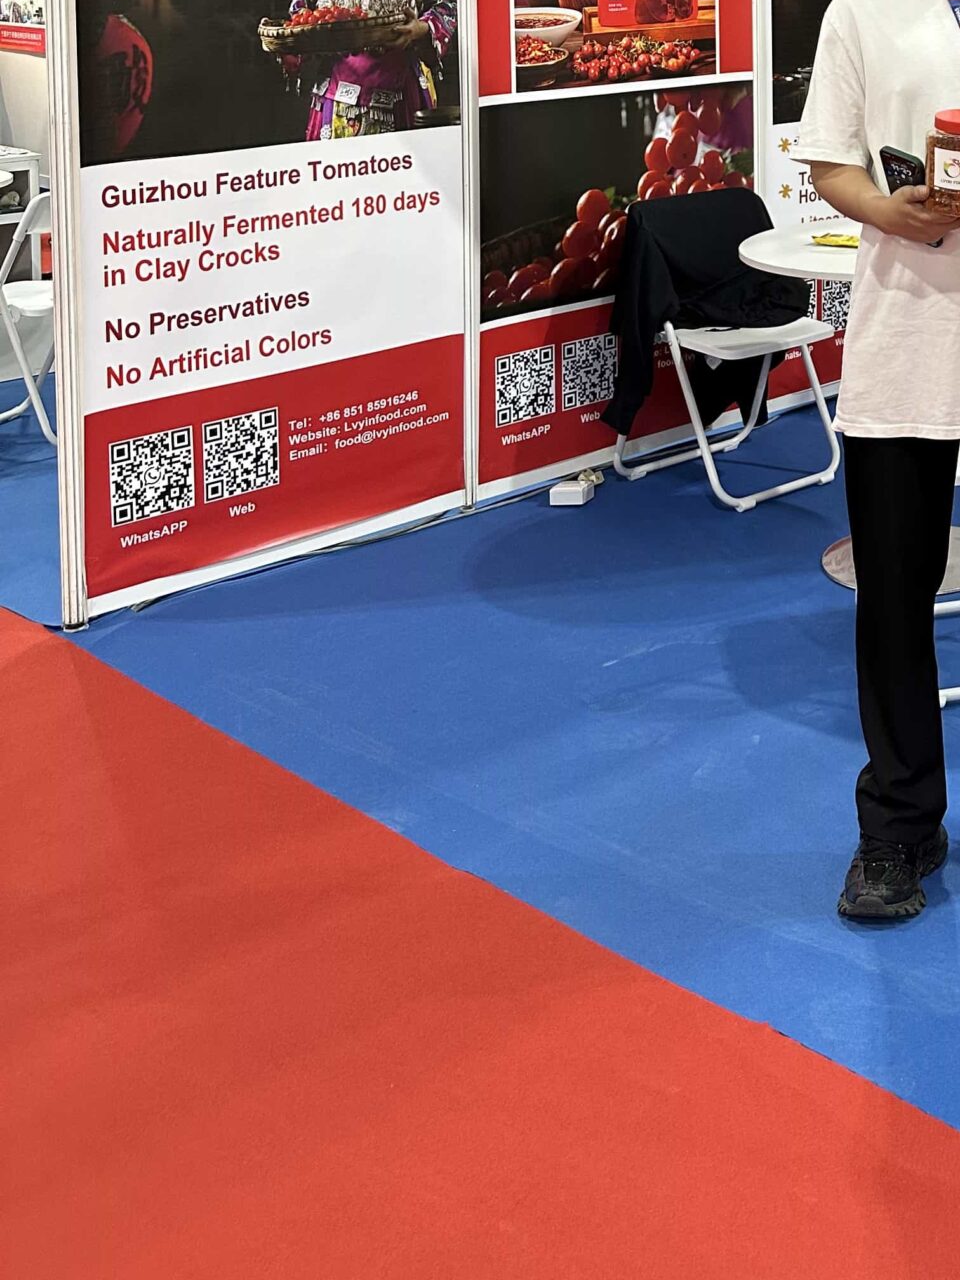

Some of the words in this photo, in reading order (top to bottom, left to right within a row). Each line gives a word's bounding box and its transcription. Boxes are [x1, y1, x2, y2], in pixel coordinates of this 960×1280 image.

[101, 178, 207, 208] Guizhou
[216, 169, 301, 195] Feature
[307, 154, 413, 183] Tomatoes
[103, 220, 214, 255] Naturally
[222, 200, 344, 238] Fermented
[351, 194, 386, 219] 180
[394, 188, 441, 214] days
[103, 264, 125, 287] in
[135, 257, 190, 282] Clay
[198, 242, 280, 272] Crocks
[105, 319, 140, 343] No
[149, 291, 310, 335] Preservatives
[106, 365, 141, 389] No
[149, 340, 250, 381] Artificial
[258, 326, 332, 357] Colors
[288, 416, 312, 432] Tel:
[319, 410, 340, 423] +86
[343, 404, 363, 418] 851
[366, 390, 419, 413] 85916246
[288, 425, 341, 446] Website:
[344, 402, 427, 432] Lvyinfood.com
[580, 410, 600, 423] Web
[289, 441, 328, 461] Email:
[334, 411, 449, 450] food@lvyinfood.com
[502, 424, 551, 445] WhatsAPP
[228, 502, 256, 518] Web
[120, 520, 188, 548] WhatsAPP
